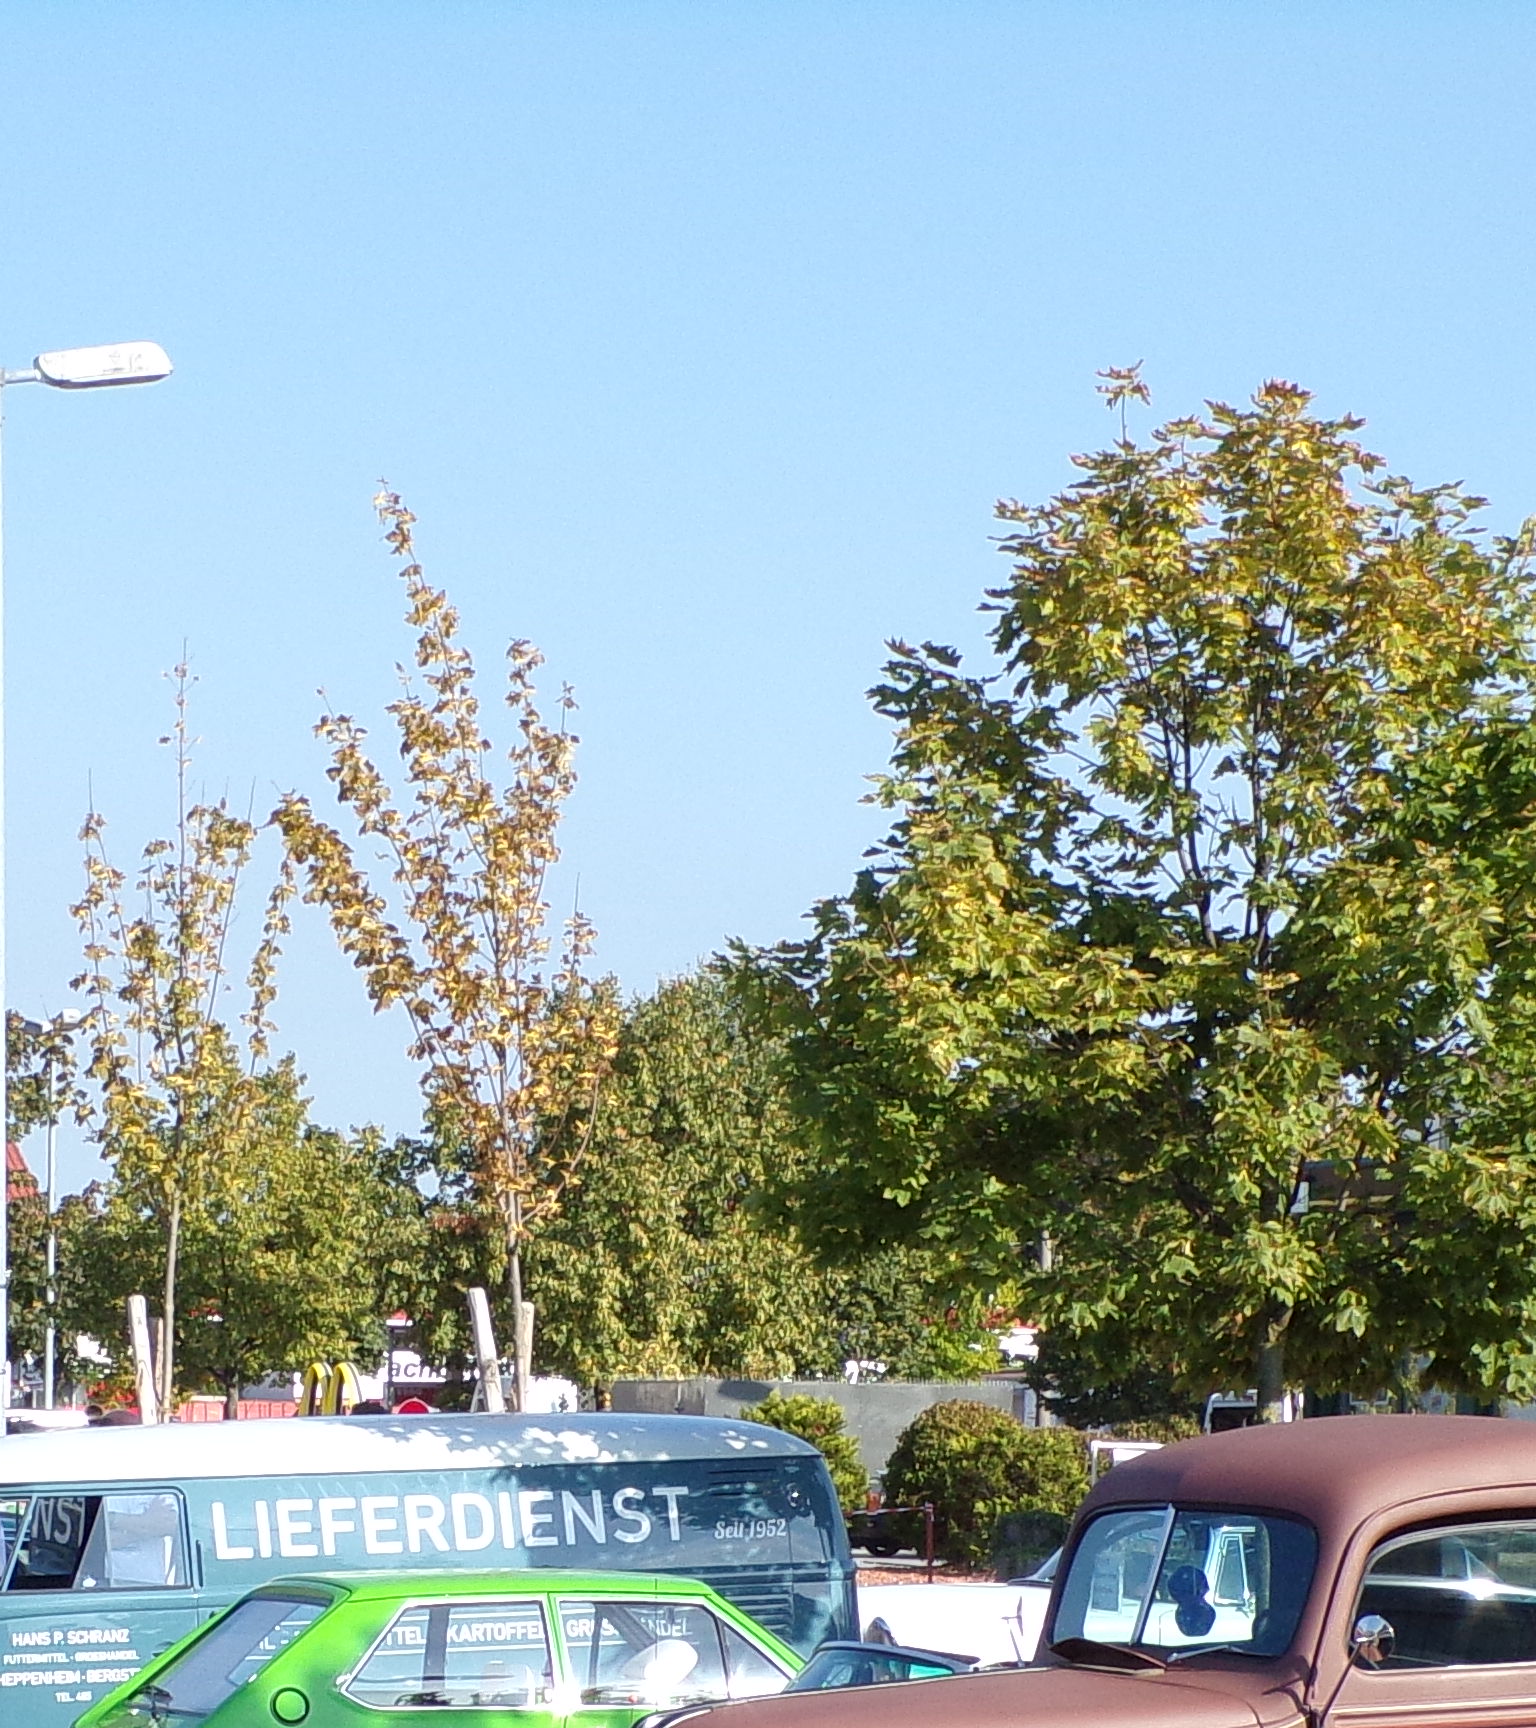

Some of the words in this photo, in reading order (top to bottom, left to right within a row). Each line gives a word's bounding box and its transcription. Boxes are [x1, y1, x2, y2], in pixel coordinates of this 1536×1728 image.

[211, 1486, 689, 1560] LIEFERDIENST
[749, 1518, 787, 1539] 1952
[12, 1631, 51, 1646] HANS
[67, 1628, 130, 1645] SCHRANZ
[86, 1667, 141, 1683] BERGST
